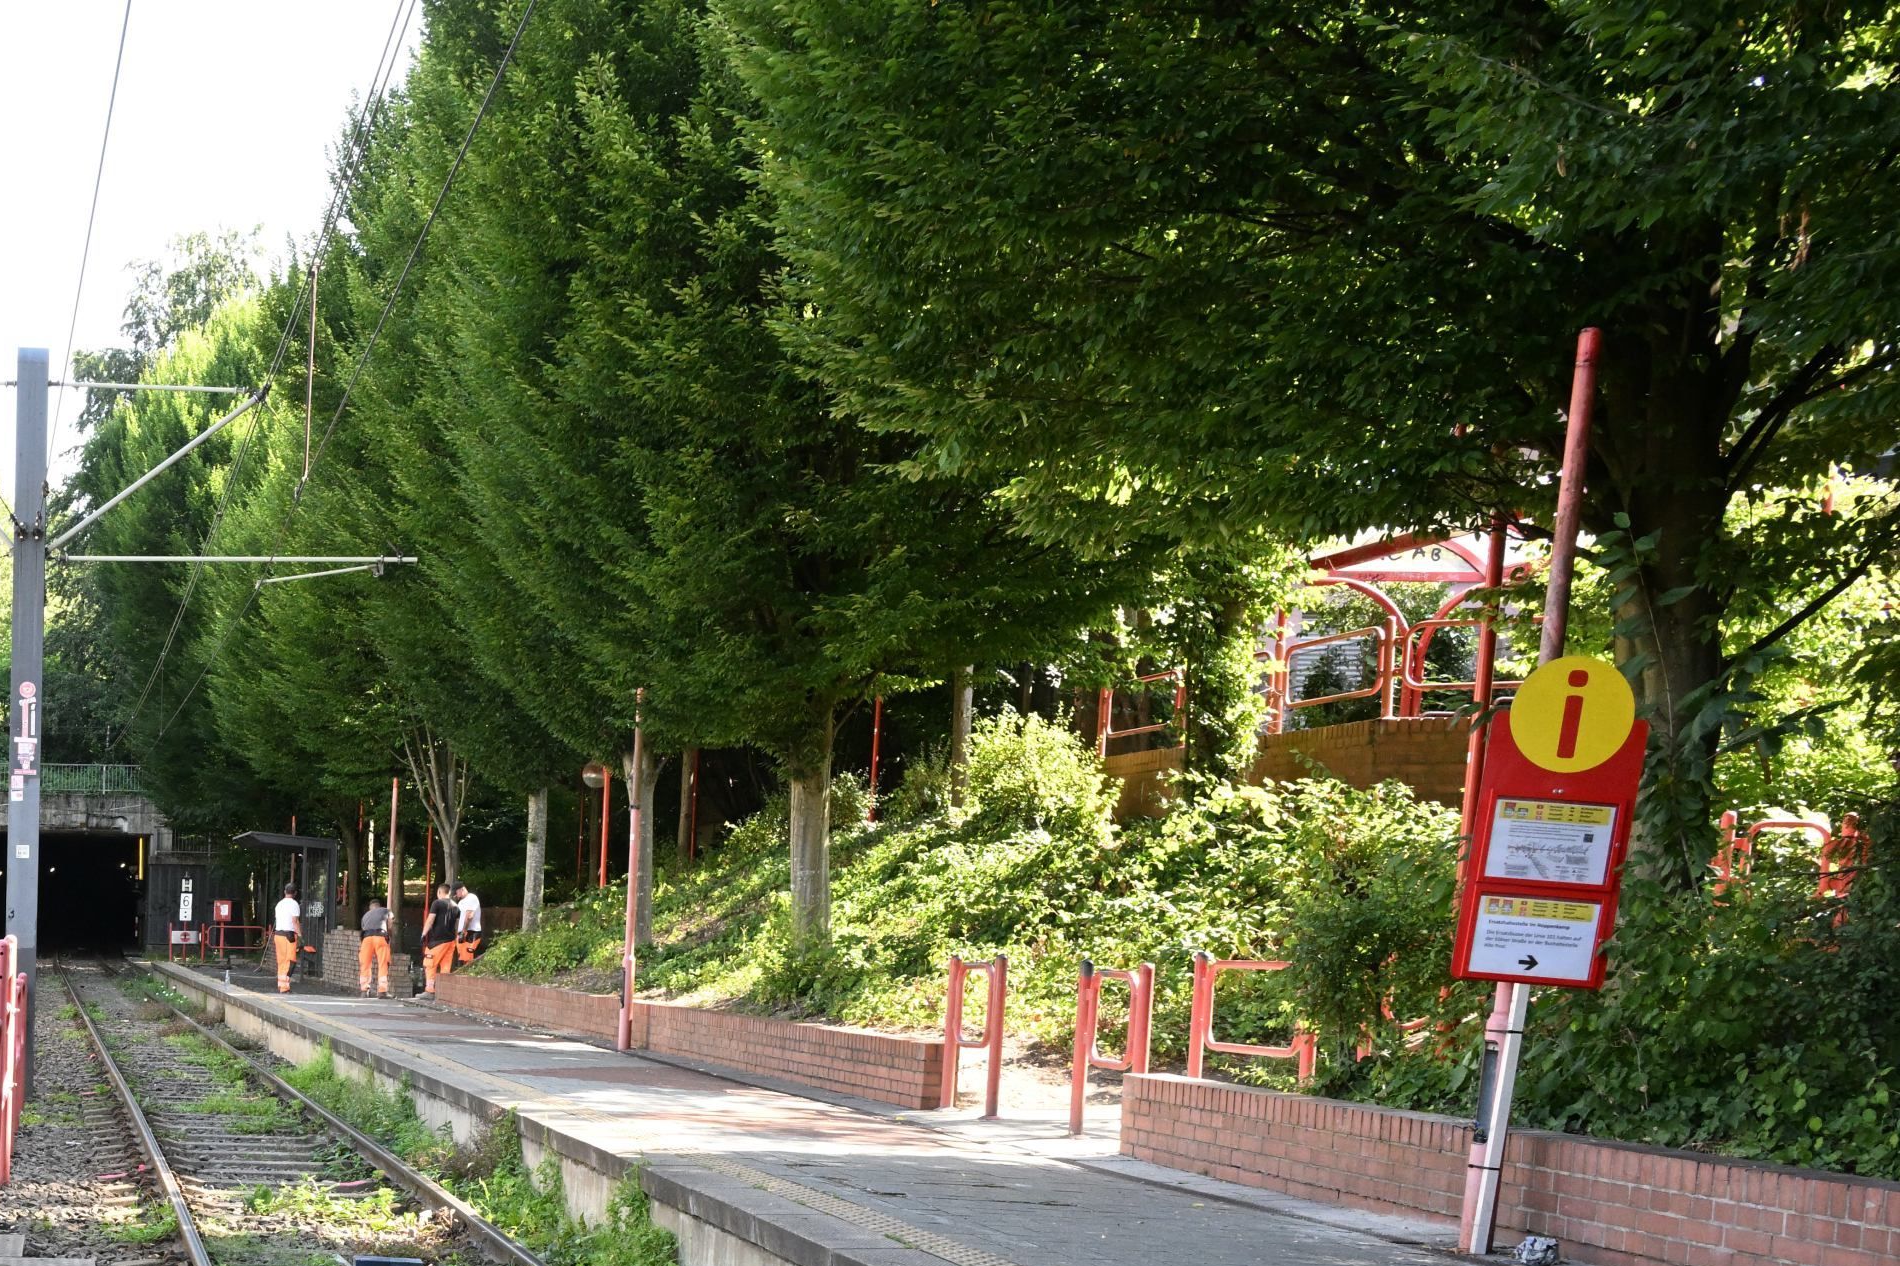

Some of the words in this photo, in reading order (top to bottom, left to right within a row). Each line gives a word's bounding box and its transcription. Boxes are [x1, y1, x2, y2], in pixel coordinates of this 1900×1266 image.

[1381, 547, 1442, 561] CAB
[1556, 669, 1589, 759] i
[181, 878, 193, 892] H
[182, 895, 190, 907] 6
